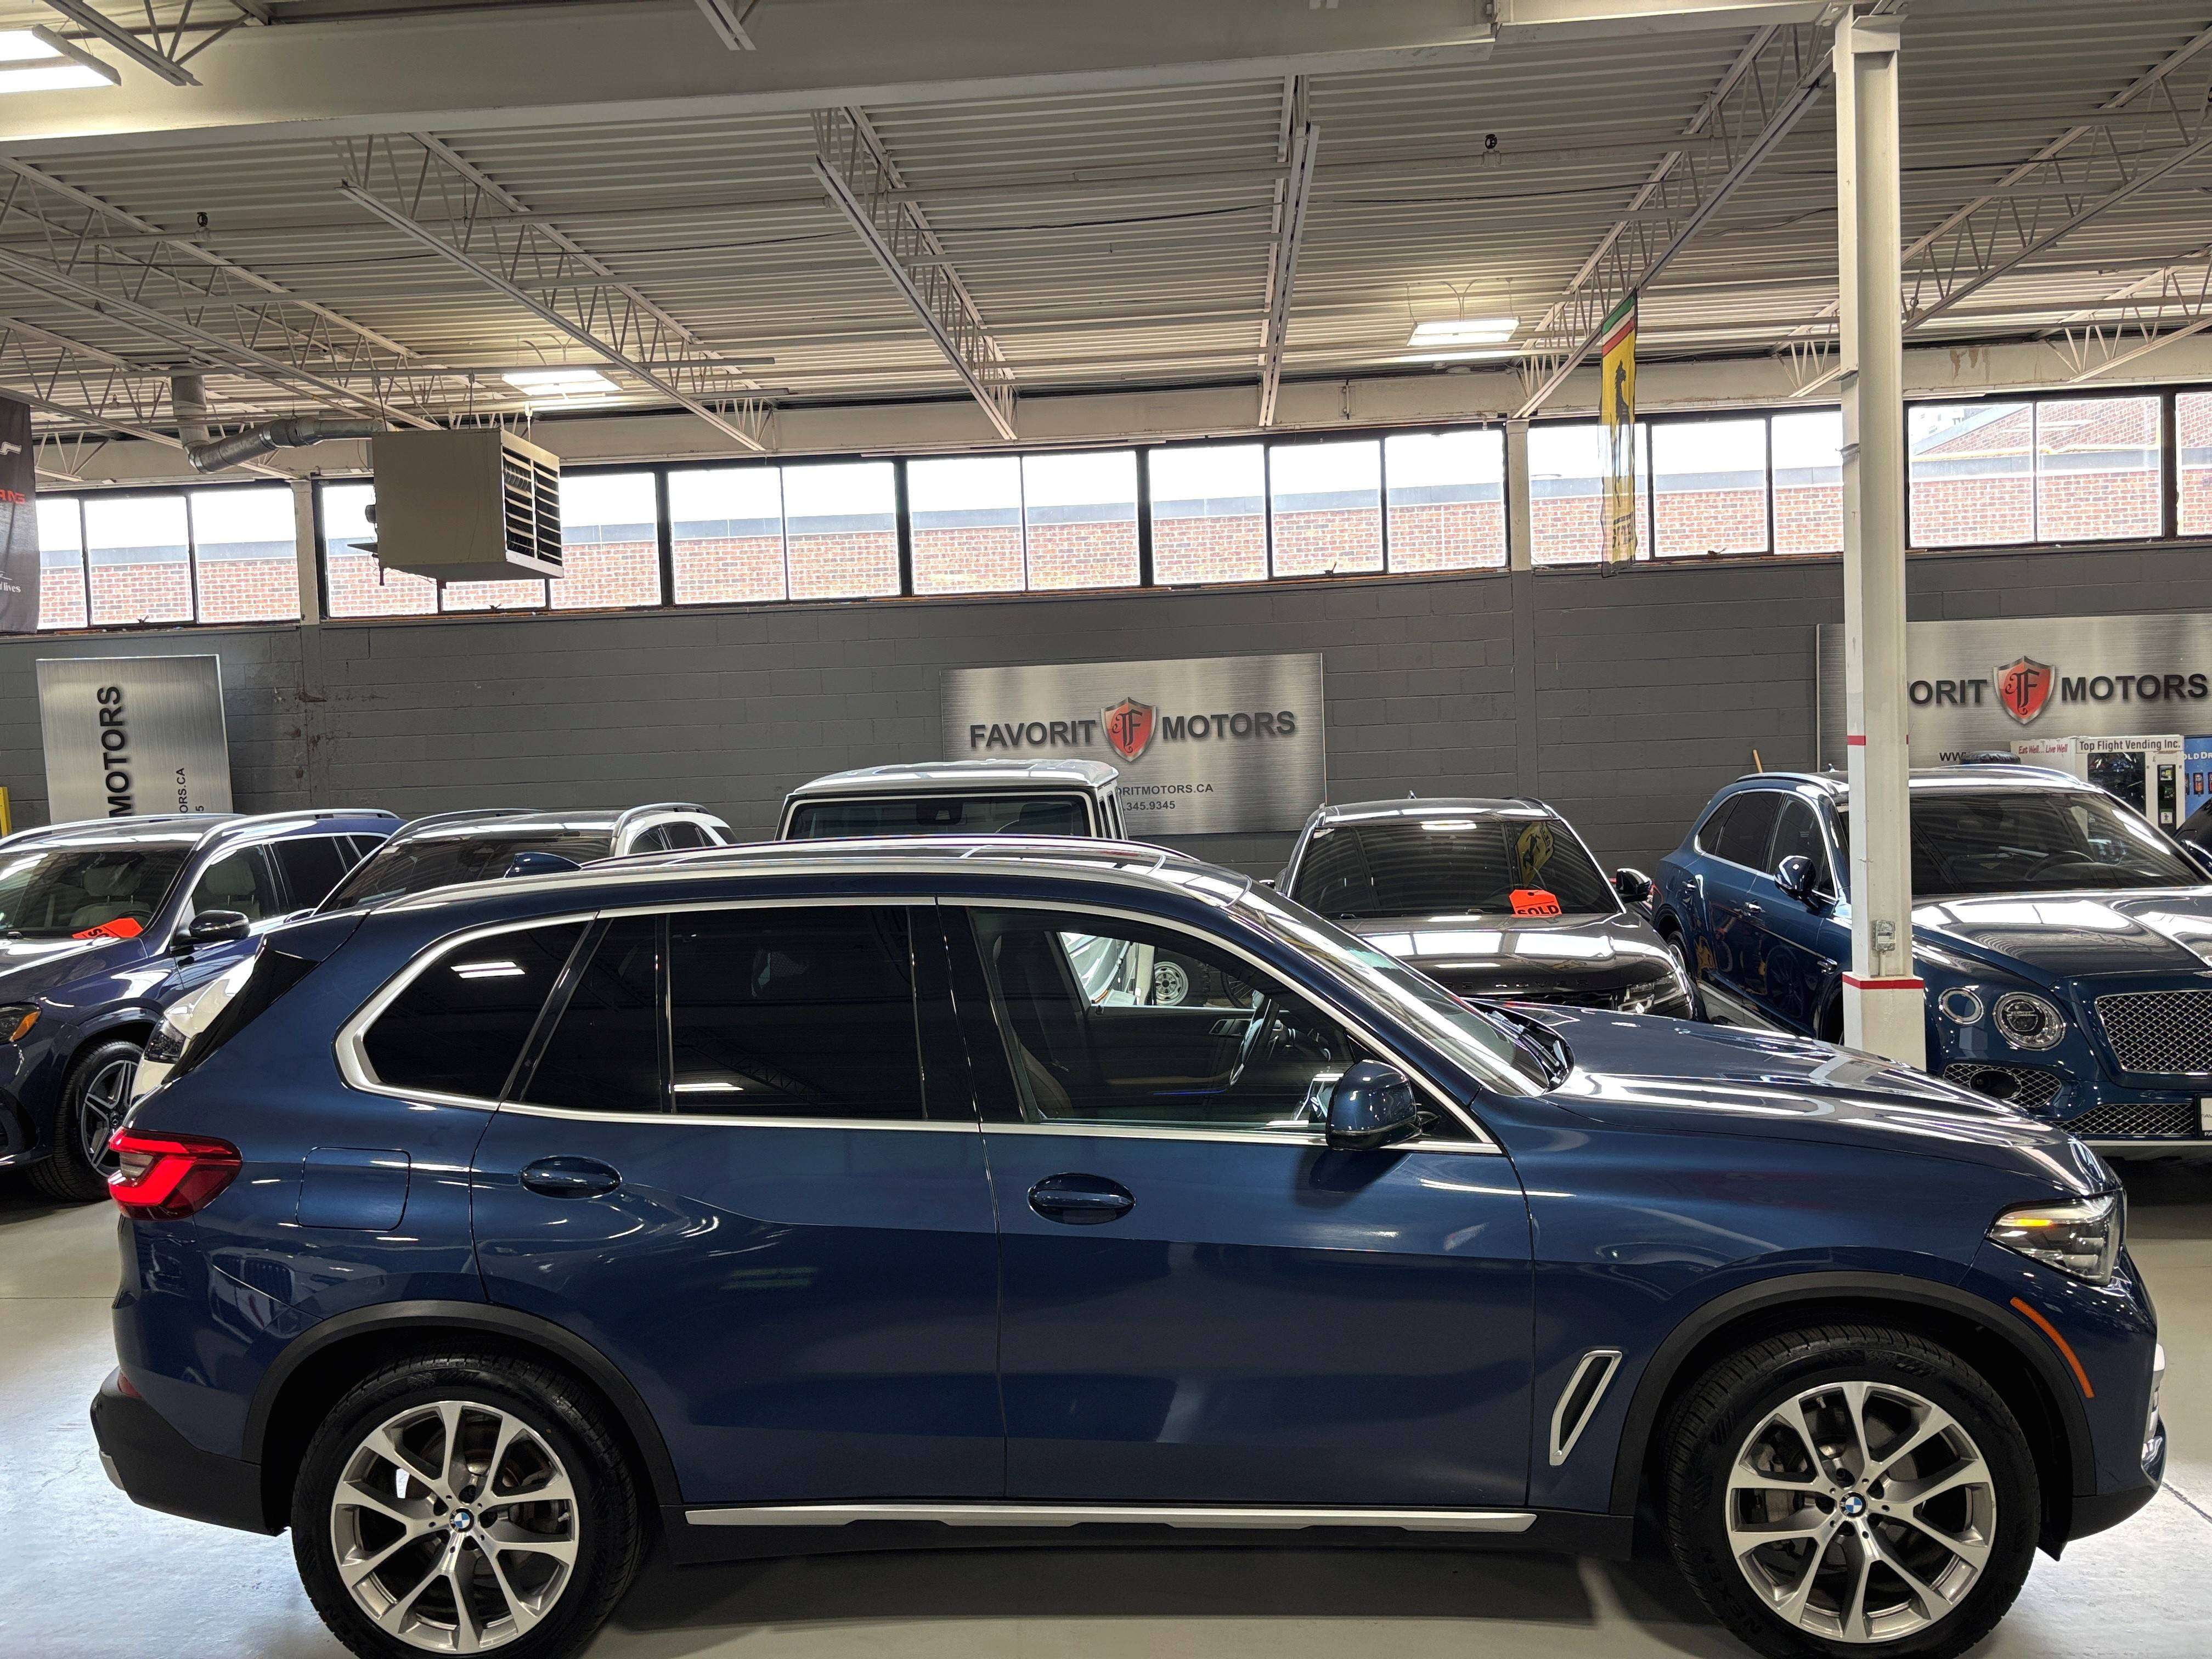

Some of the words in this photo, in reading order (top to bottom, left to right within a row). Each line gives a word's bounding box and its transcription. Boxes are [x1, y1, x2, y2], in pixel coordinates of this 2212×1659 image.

[2062, 674, 2208, 701] MOTORS
[970, 720, 1096, 748] FAVORIT
[1163, 711, 1296, 740] MOTORS
[97, 687, 132, 817] MOTORS
[2019, 746, 2028, 754] Eat
[2046, 744, 2056, 753] Live
[2057, 743, 2068, 753] Well
[2079, 741, 2095, 752] Top
[2097, 740, 2123, 752] Flight
[2125, 739, 2162, 751] Vending
[2164, 739, 2181, 748] Inc.
[1939, 752, 1966, 761] WW
[176, 768, 189, 814] ORS.CA
[1517, 905, 1559, 915] SOLD
